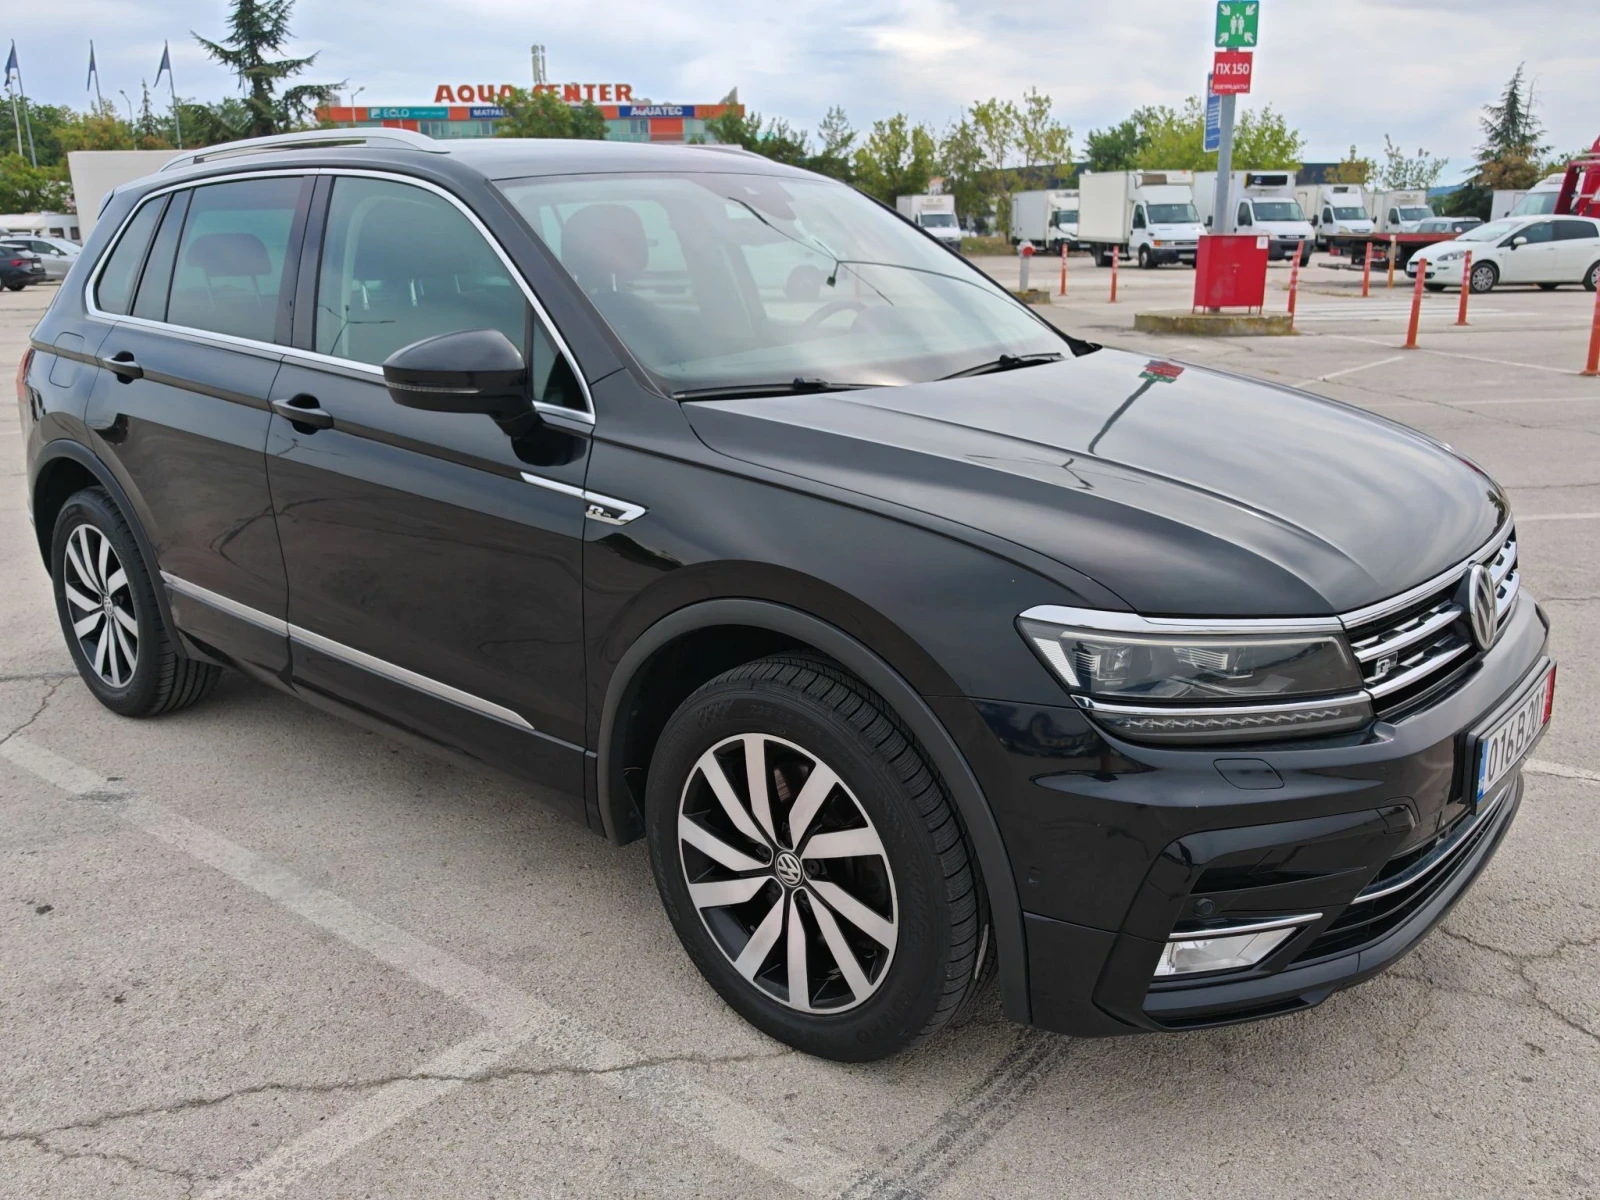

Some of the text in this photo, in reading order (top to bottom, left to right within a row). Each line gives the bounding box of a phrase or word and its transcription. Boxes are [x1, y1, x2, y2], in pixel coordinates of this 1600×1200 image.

[1215, 62, 1250, 75] ПХ 150
[434, 84, 516, 103] AQUA
[630, 106, 683, 116] AQUATEC
